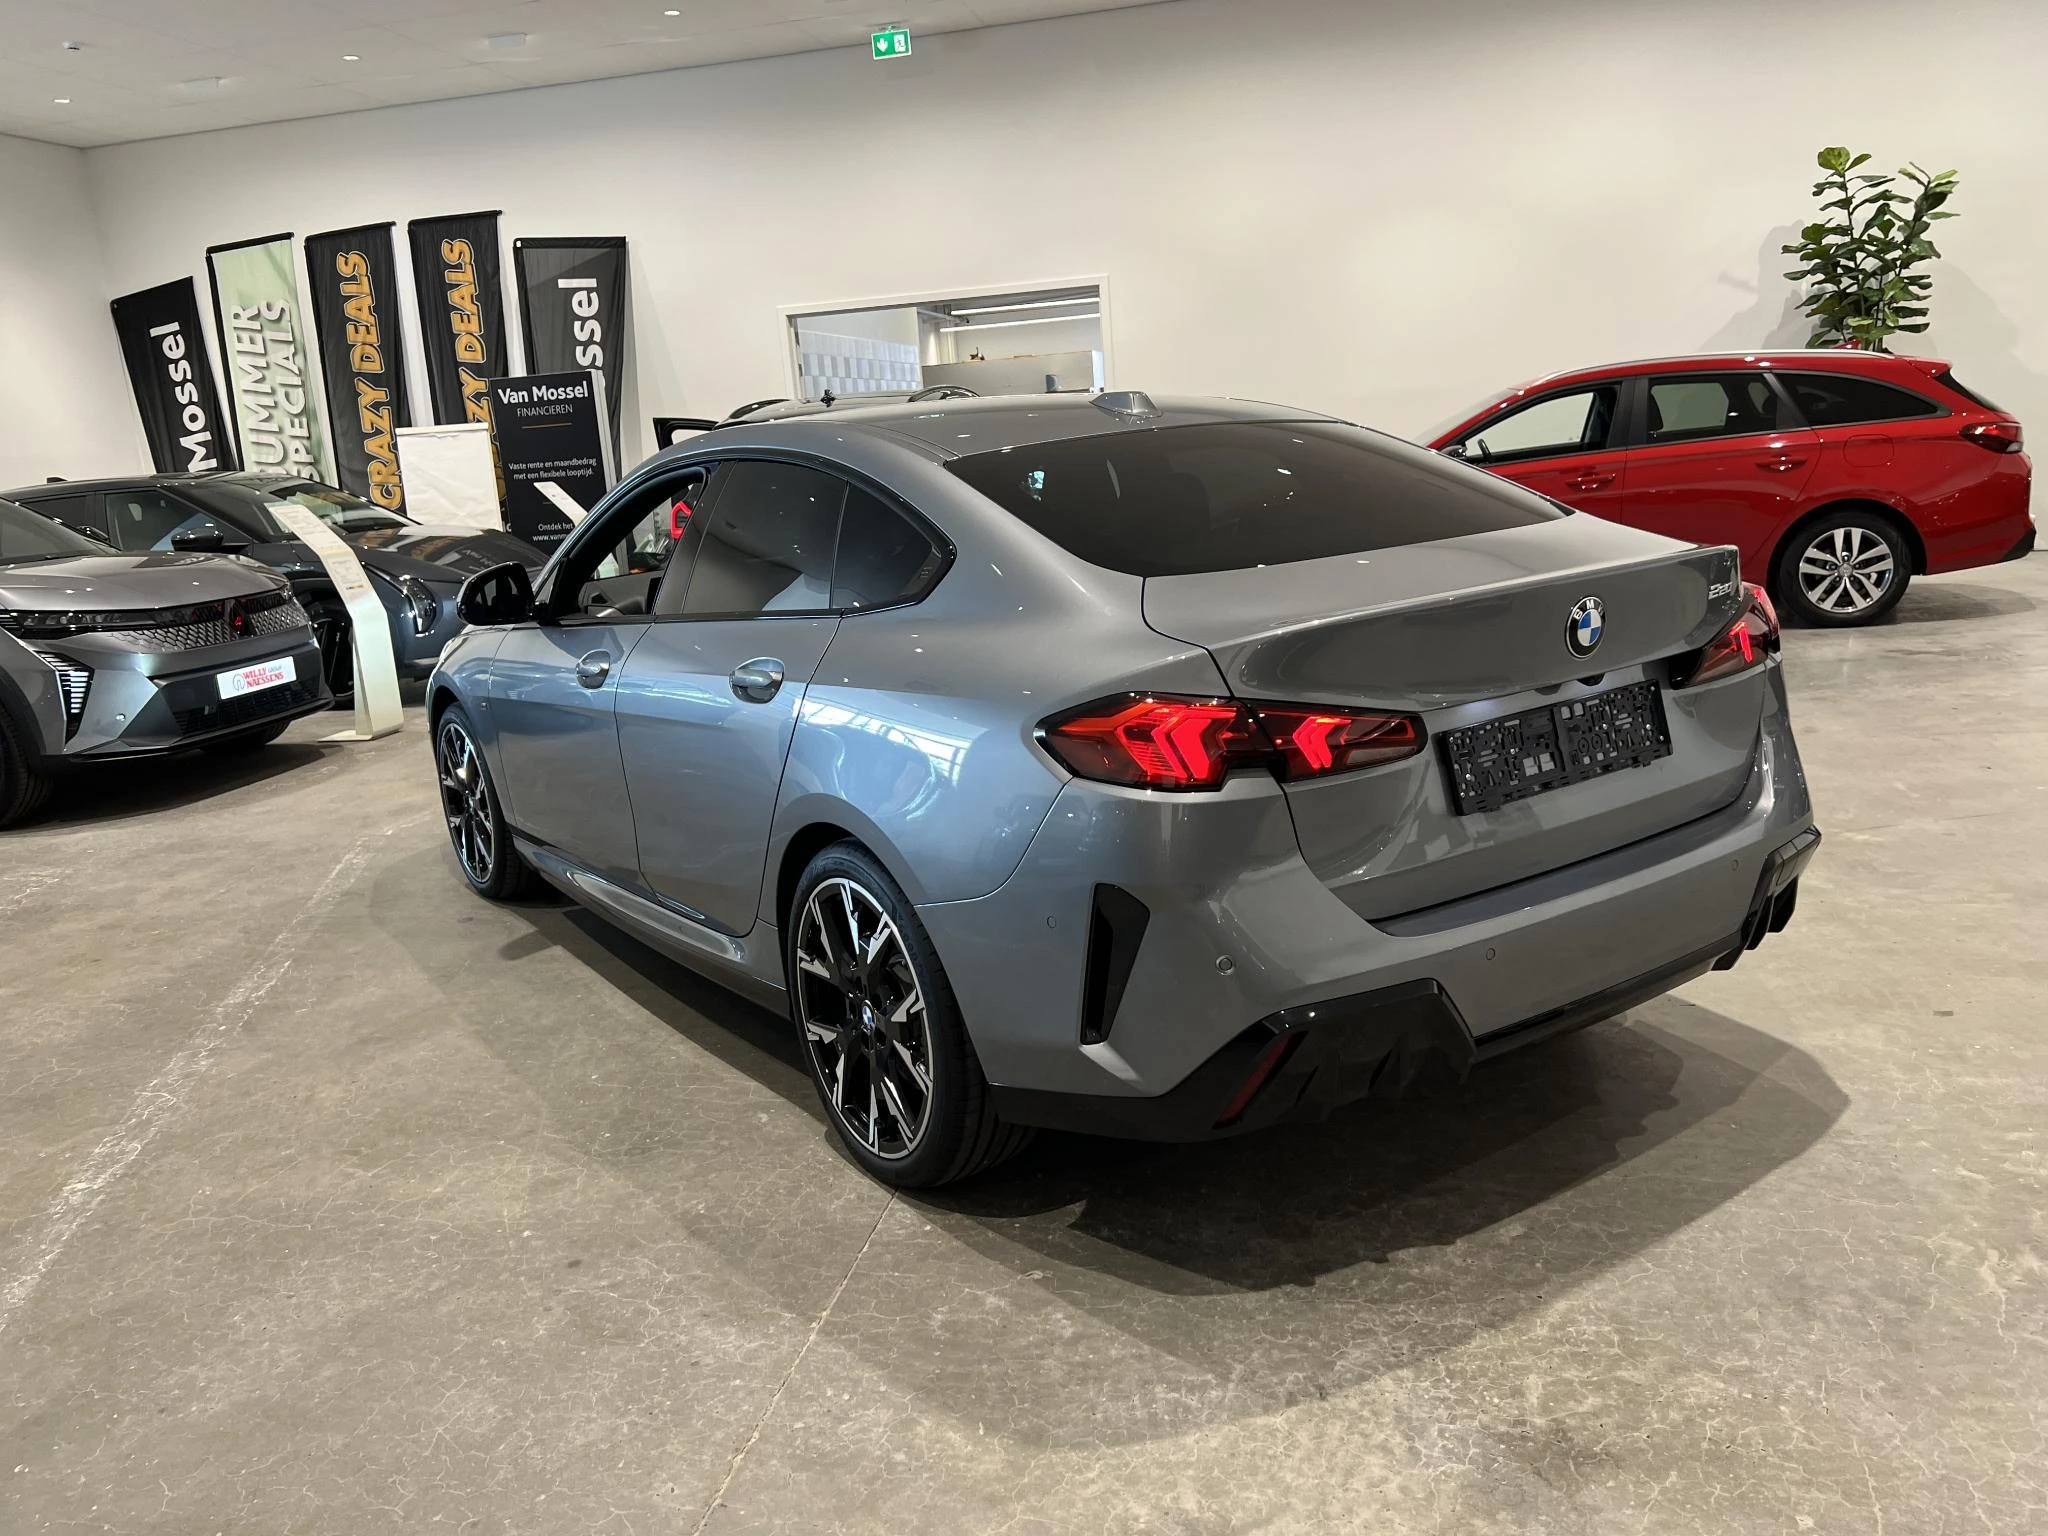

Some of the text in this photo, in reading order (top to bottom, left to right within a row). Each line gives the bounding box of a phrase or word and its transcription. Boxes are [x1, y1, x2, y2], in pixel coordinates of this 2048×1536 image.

[441, 239, 487, 363] DEALS
[558, 278, 604, 368] ssel
[337, 250, 403, 510] CRAZY DEALS
[149, 321, 218, 473] Mossel
[498, 381, 588, 404] Van Mossel
[517, 404, 573, 417] FINANCIEREN
[508, 462, 526, 470] Vaste
[527, 461, 544, 469] rente
[553, 458, 597, 467] maandbedrag
[513, 472, 526, 480] met
[540, 470, 566, 478] flexibele
[538, 523, 562, 531] Ontdek
[243, 667, 267, 680] WILLY
